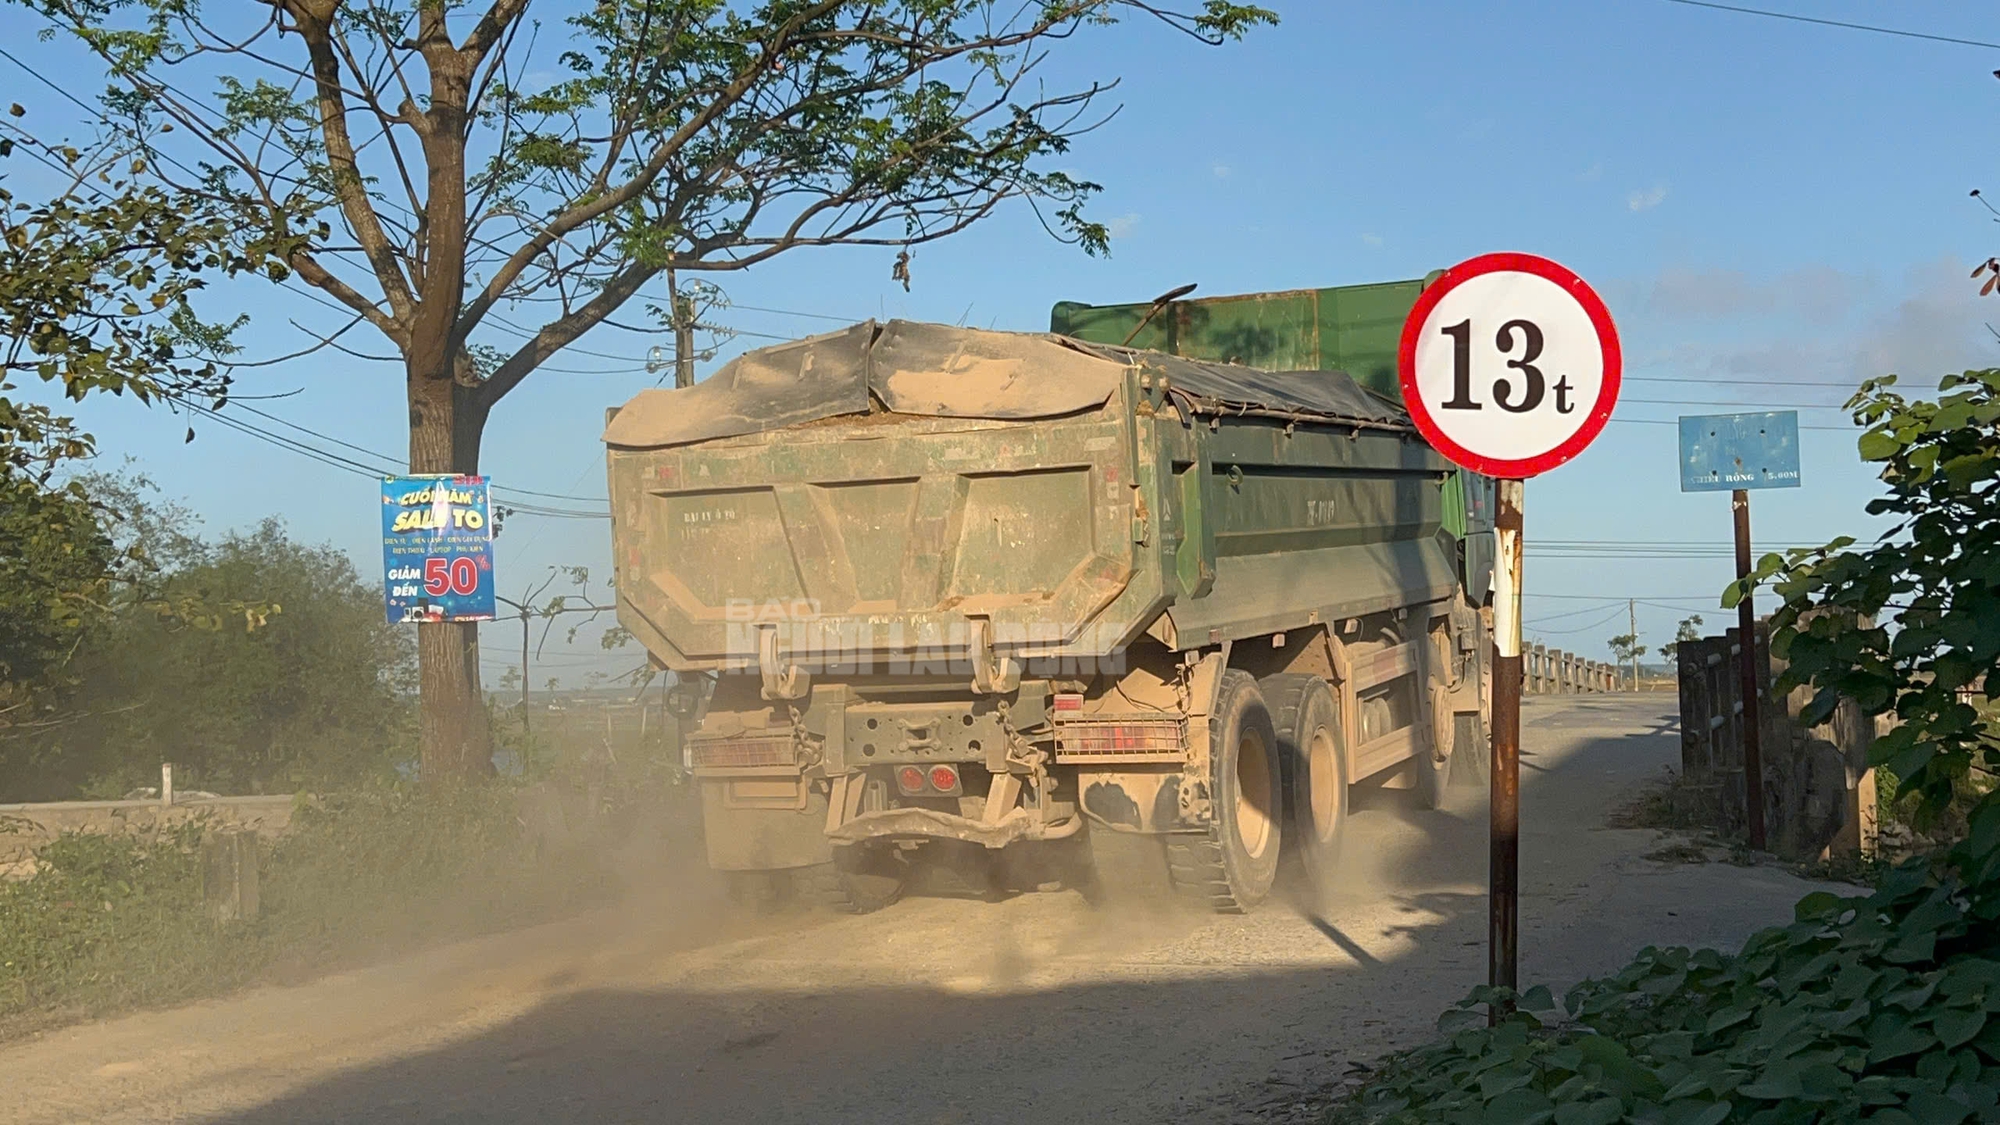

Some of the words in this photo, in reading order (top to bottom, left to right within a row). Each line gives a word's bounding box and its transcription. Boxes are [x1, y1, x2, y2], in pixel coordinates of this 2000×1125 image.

[392, 508, 447, 532] SAL
[452, 508, 484, 529] TO
[388, 565, 421, 580] GIẢM
[392, 582, 418, 597] ĐẾN
